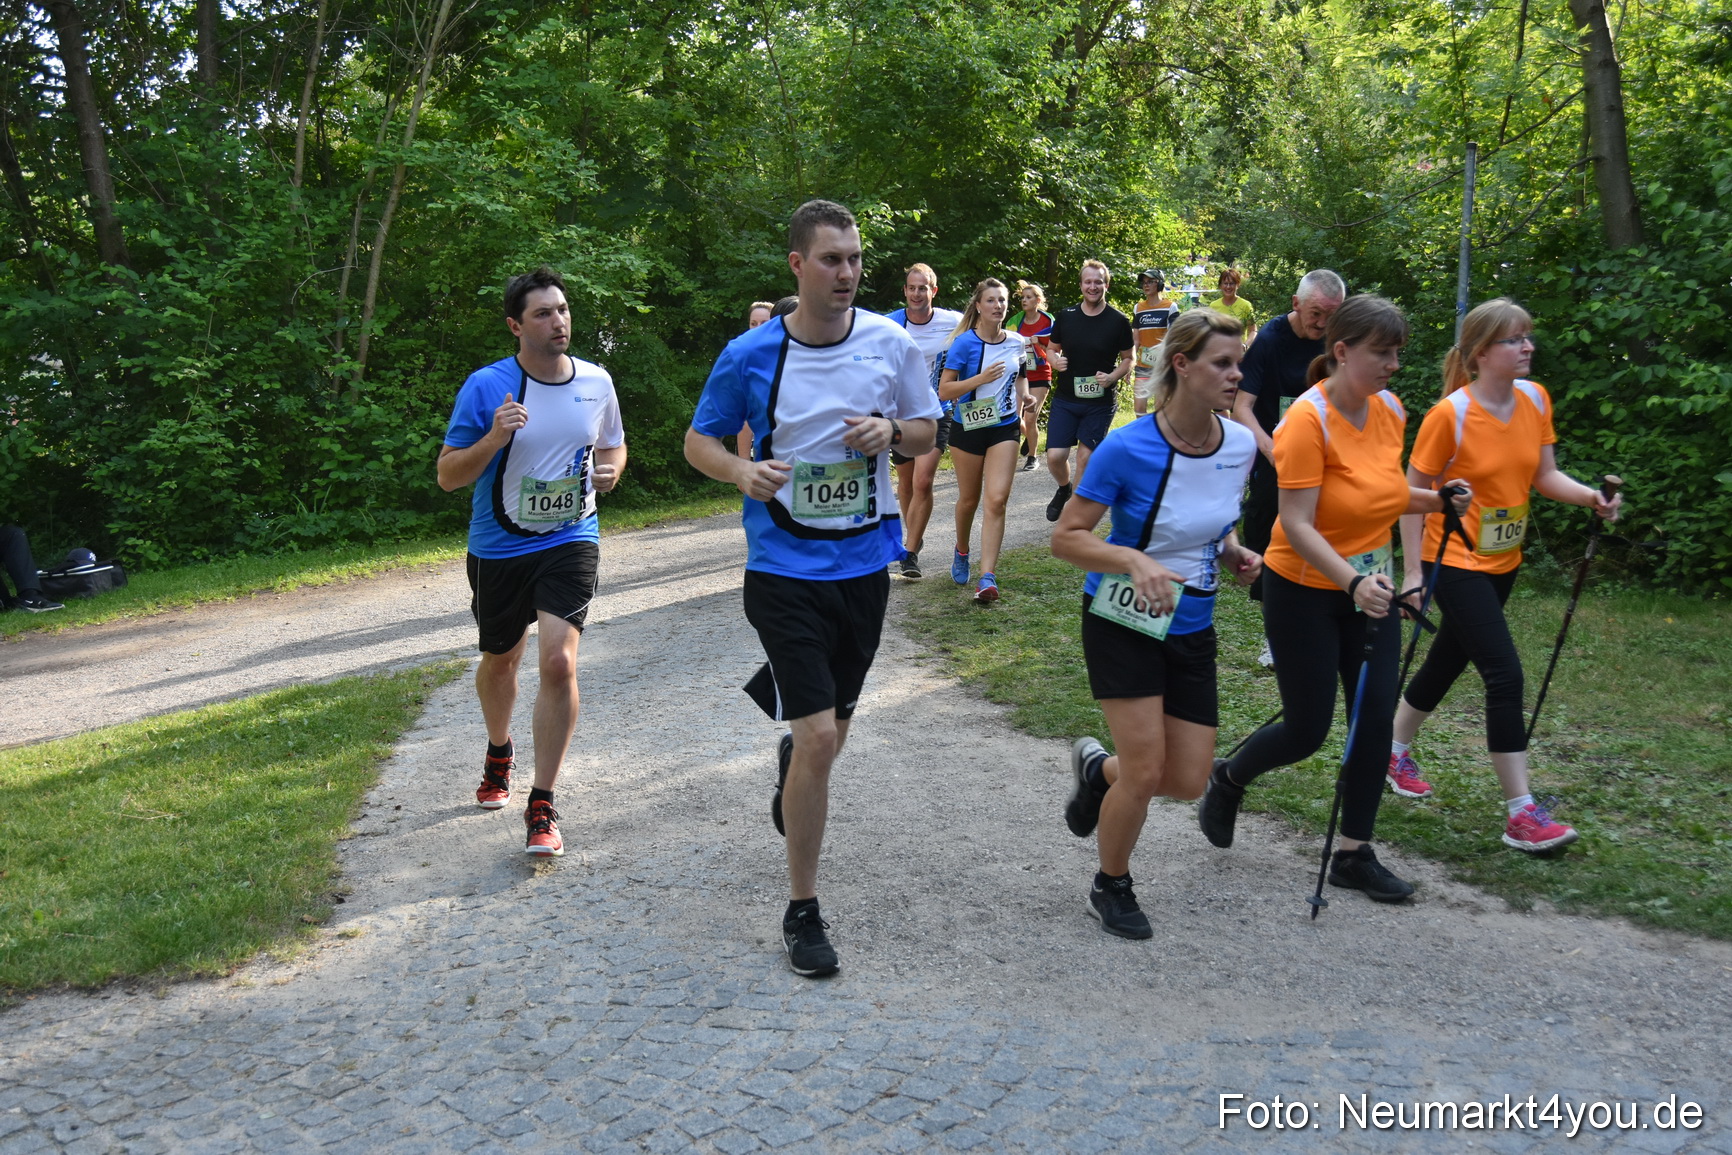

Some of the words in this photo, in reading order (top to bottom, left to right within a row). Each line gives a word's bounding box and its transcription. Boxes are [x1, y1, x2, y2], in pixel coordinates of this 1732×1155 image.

[1078, 383, 1100, 393] 1867
[965, 407, 994, 422] 1052
[803, 480, 859, 503] 1049
[528, 493, 573, 511] 1048
[1494, 519, 1522, 541] 106
